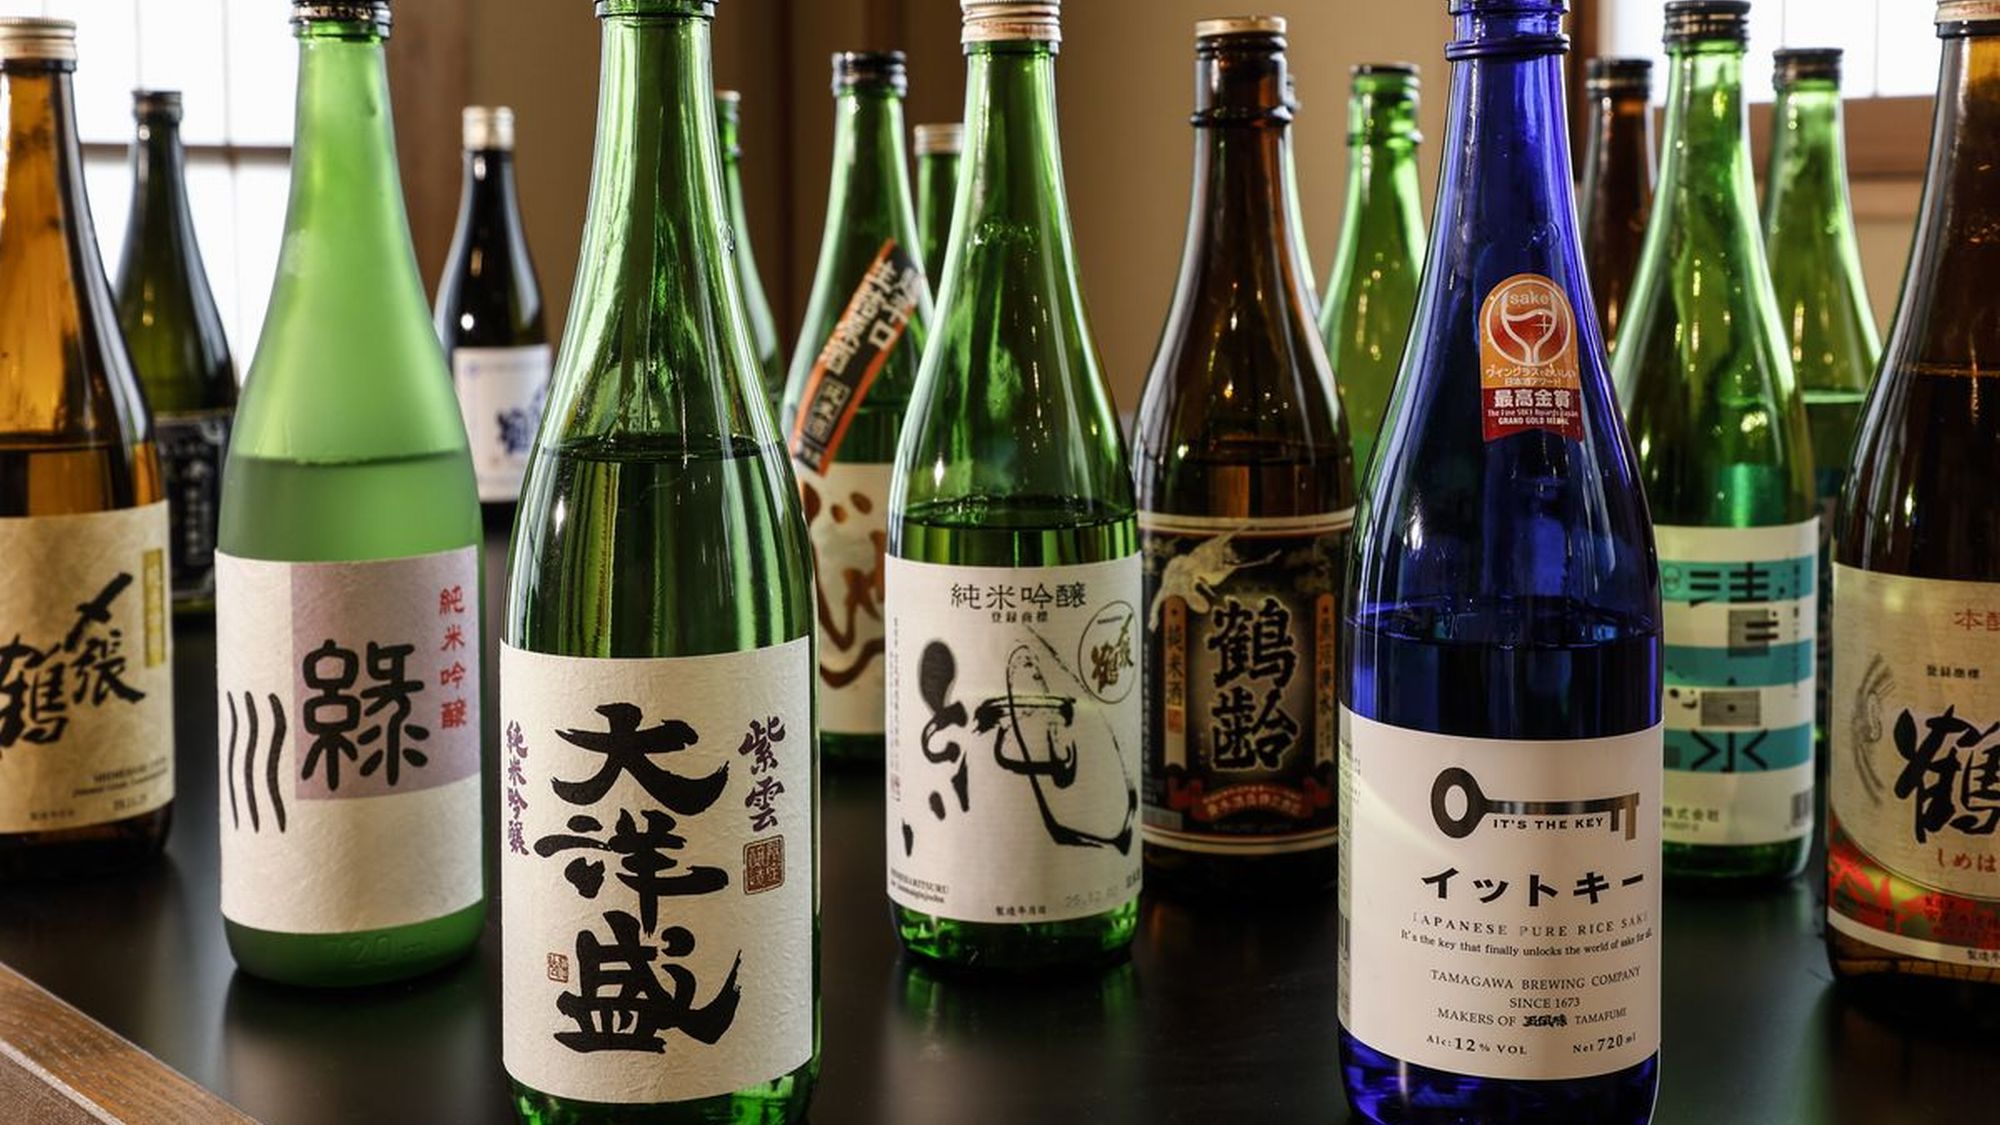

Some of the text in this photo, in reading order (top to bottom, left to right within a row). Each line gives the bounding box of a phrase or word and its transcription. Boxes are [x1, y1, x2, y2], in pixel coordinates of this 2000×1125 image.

[1494, 389, 1570, 408] 最高金賞
[951, 582, 1086, 609] 純米吟醸
[439, 584, 467, 730] 純米吟醸
[738, 714, 786, 833] 紫雲
[1894, 704, 2000, 845] 鶴
[506, 720, 529, 856] 純米吟醸
[1493, 817, 1604, 830] IT'S THE KEY
[533, 702, 742, 1054] 大洋盛
[1421, 867, 1644, 907] イットキー
[1520, 925, 1568, 937] PURE
[1577, 920, 1614, 936] RICE
[1420, 934, 1435, 945] the
[1438, 937, 1456, 950] key
[1460, 941, 1481, 953] that
[1485, 944, 1519, 957] finally
[1523, 946, 1562, 956] unlocks
[1565, 946, 1580, 955] the
[1584, 941, 1609, 953] world
[1610, 939, 1620, 950] of
[1430, 966, 1642, 990] TAMAGAWA BREWING COMPANY
[1509, 997, 1581, 1009] SINCE 1673
[1438, 1007, 1495, 1025] MAKERS
[1497, 1015, 1516, 1027] OF
[1575, 1007, 1628, 1025] TAMAFUMI
[1496, 1046, 1528, 1055] VOL
[1572, 1043, 1594, 1054] Net
